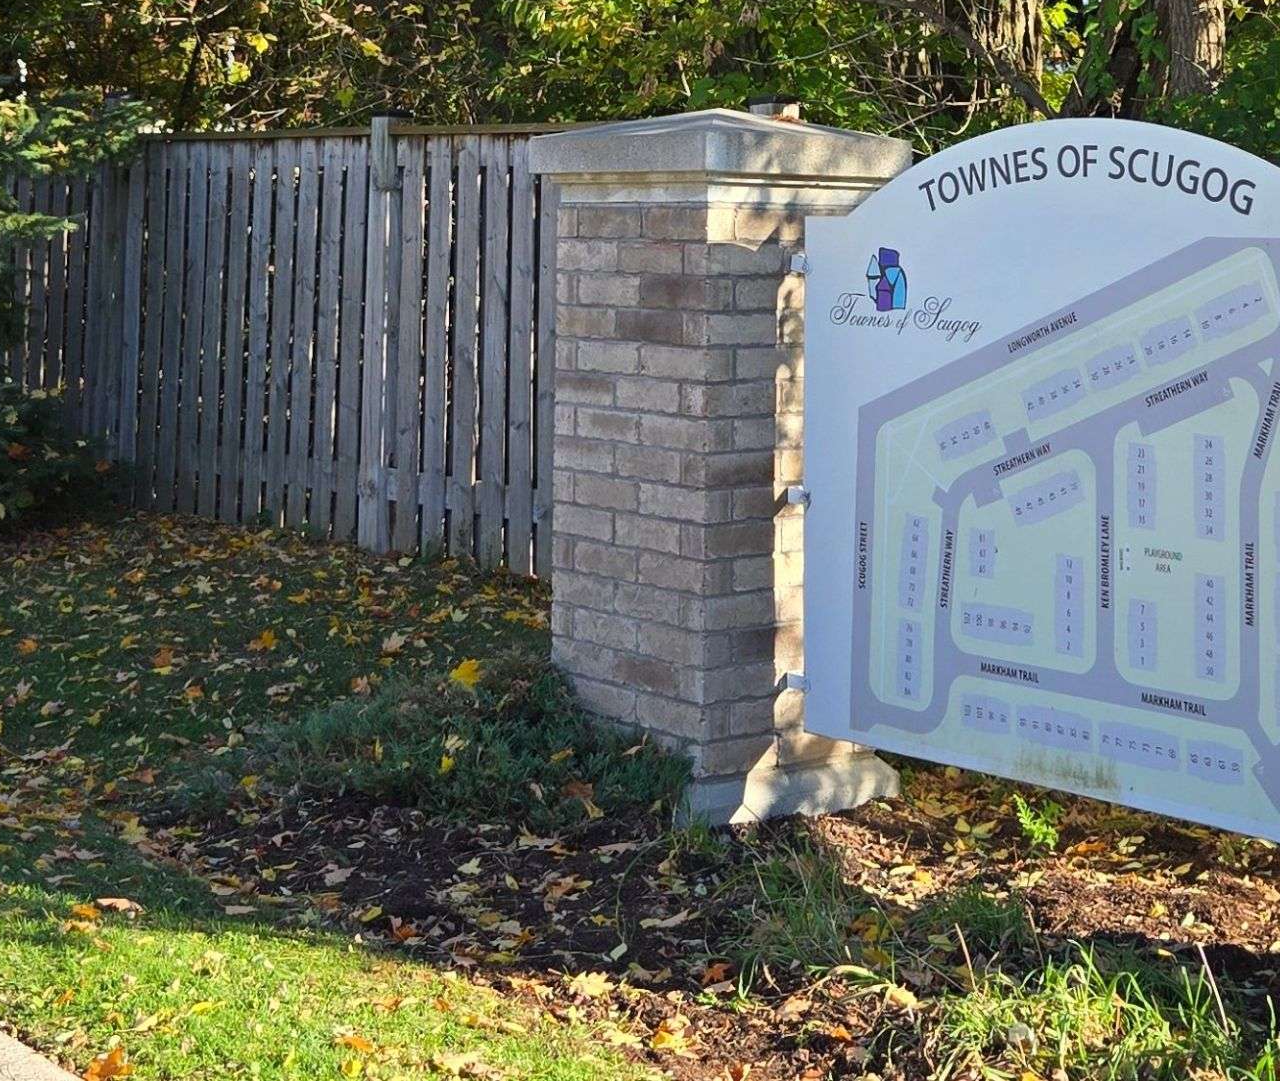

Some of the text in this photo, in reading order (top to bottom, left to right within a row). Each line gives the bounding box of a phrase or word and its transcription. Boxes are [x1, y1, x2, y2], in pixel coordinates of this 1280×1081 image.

[918, 145, 1256, 215] TOWNES OF SCUGOG
[830, 293, 981, 342] Townes of Scugog
[1008, 312, 1077, 353] LONGWORTH AVENUE
[1145, 370, 1208, 407] STREATHERN WAY
[1253, 408, 1275, 459] MARKHAM
[993, 442, 1051, 476] STREATHERN WAY
[858, 554, 867, 589] SCUGOG
[940, 529, 953, 608] STREATHERN WAY
[1101, 514, 1109, 609] KEN BROMLEY LANE
[1155, 563, 1172, 575] AREA
[1245, 542, 1254, 626] MARKHAM TRAIL
[980, 662, 1039, 683] MARKHAM TRAIL
[1141, 692, 1207, 716] MARKHAM TRAIL
